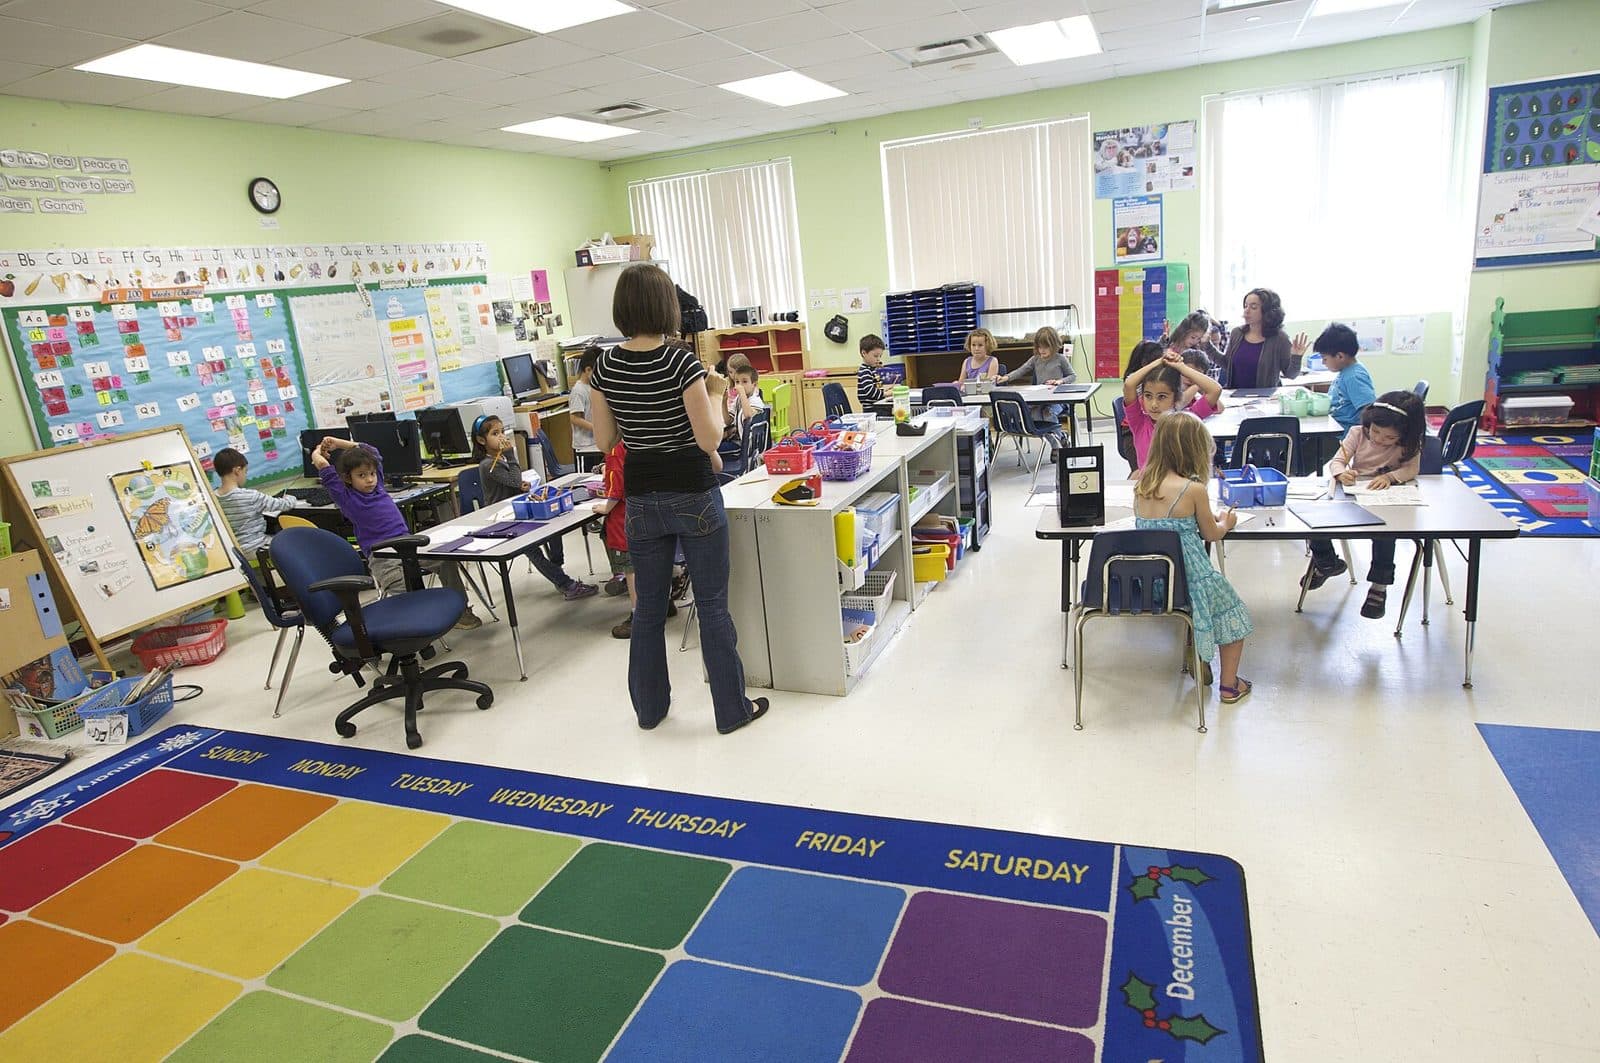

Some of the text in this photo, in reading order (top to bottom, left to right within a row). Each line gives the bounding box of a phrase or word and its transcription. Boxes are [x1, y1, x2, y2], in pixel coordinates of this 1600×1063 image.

[53, 158, 75, 167] real
[83, 159, 117, 171] peace
[120, 161, 128, 170] in
[9, 178, 27, 187] we
[29, 180, 54, 189] shall
[90, 180, 101, 190] to
[105, 181, 133, 192] begin
[18, 253, 36, 267] Bb
[46, 252, 62, 266] Cc
[72, 252, 89, 265] Dd
[98, 251, 113, 264] Ee
[122, 251, 135, 263] Ff
[143, 250, 162, 268] Gg
[170, 250, 184, 262] Hh
[193, 250, 204, 262] Ii
[213, 249, 224, 264] Jj
[234, 248, 247, 260] Kk
[304, 247, 318, 257] Oo
[324, 246, 335, 260] Pp
[128, 290, 142, 298] 100
[25, 315, 33, 323] A
[75, 309, 82, 317] B
[1078, 474, 1089, 490] 3
[77, 753, 150, 791] January
[200, 746, 1090, 885] SUNDAY MONDAY TUESDAY WEDNESDAY THURSDAY FRIDAY SATURDAY
[1165, 894, 1196, 1001] December
